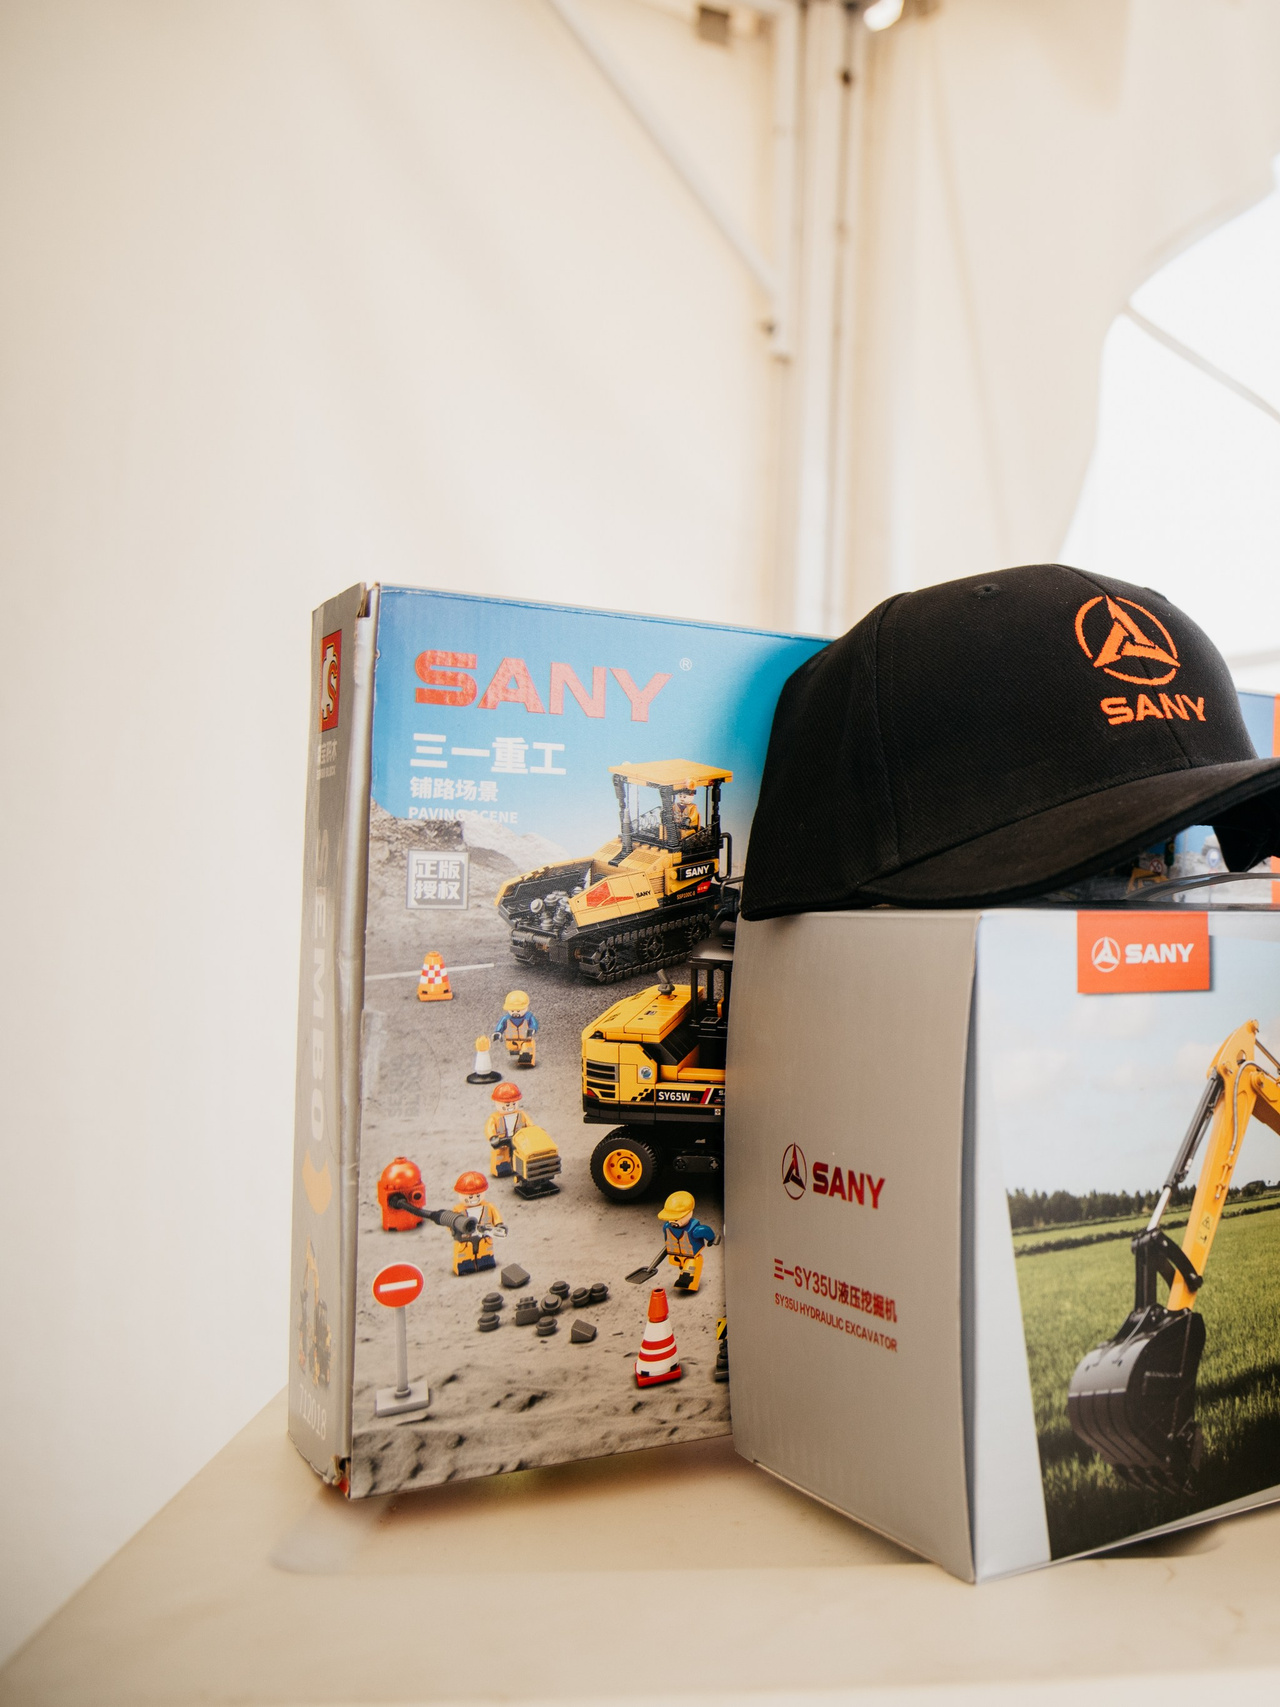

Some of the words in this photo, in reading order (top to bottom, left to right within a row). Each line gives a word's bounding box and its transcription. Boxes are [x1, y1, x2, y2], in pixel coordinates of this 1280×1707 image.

[414, 649, 673, 723] SANY
[1100, 692, 1207, 726] SANY
[409, 732, 567, 776] 三一重工
[409, 776, 499, 804] 铺路场景
[408, 806, 465, 821] PAVING
[415, 859, 462, 880] 正版
[685, 864, 710, 878] SANY
[414, 880, 462, 901] 授权
[636, 890, 652, 898] SANY
[1124, 943, 1195, 965] SANY
[311, 827, 330, 1142] SEMBO
[658, 1091, 691, 1102] SY65W
[811, 1161, 886, 1210] SANY
[773, 1258, 898, 1323] 三一SY35U液压挖掘机
[774, 1292, 799, 1313] SY35U
[799, 1302, 844, 1331] HYDRAULIC
[845, 1320, 898, 1353] EXCAVATOR
[299, 1382, 328, 1441] 712018
